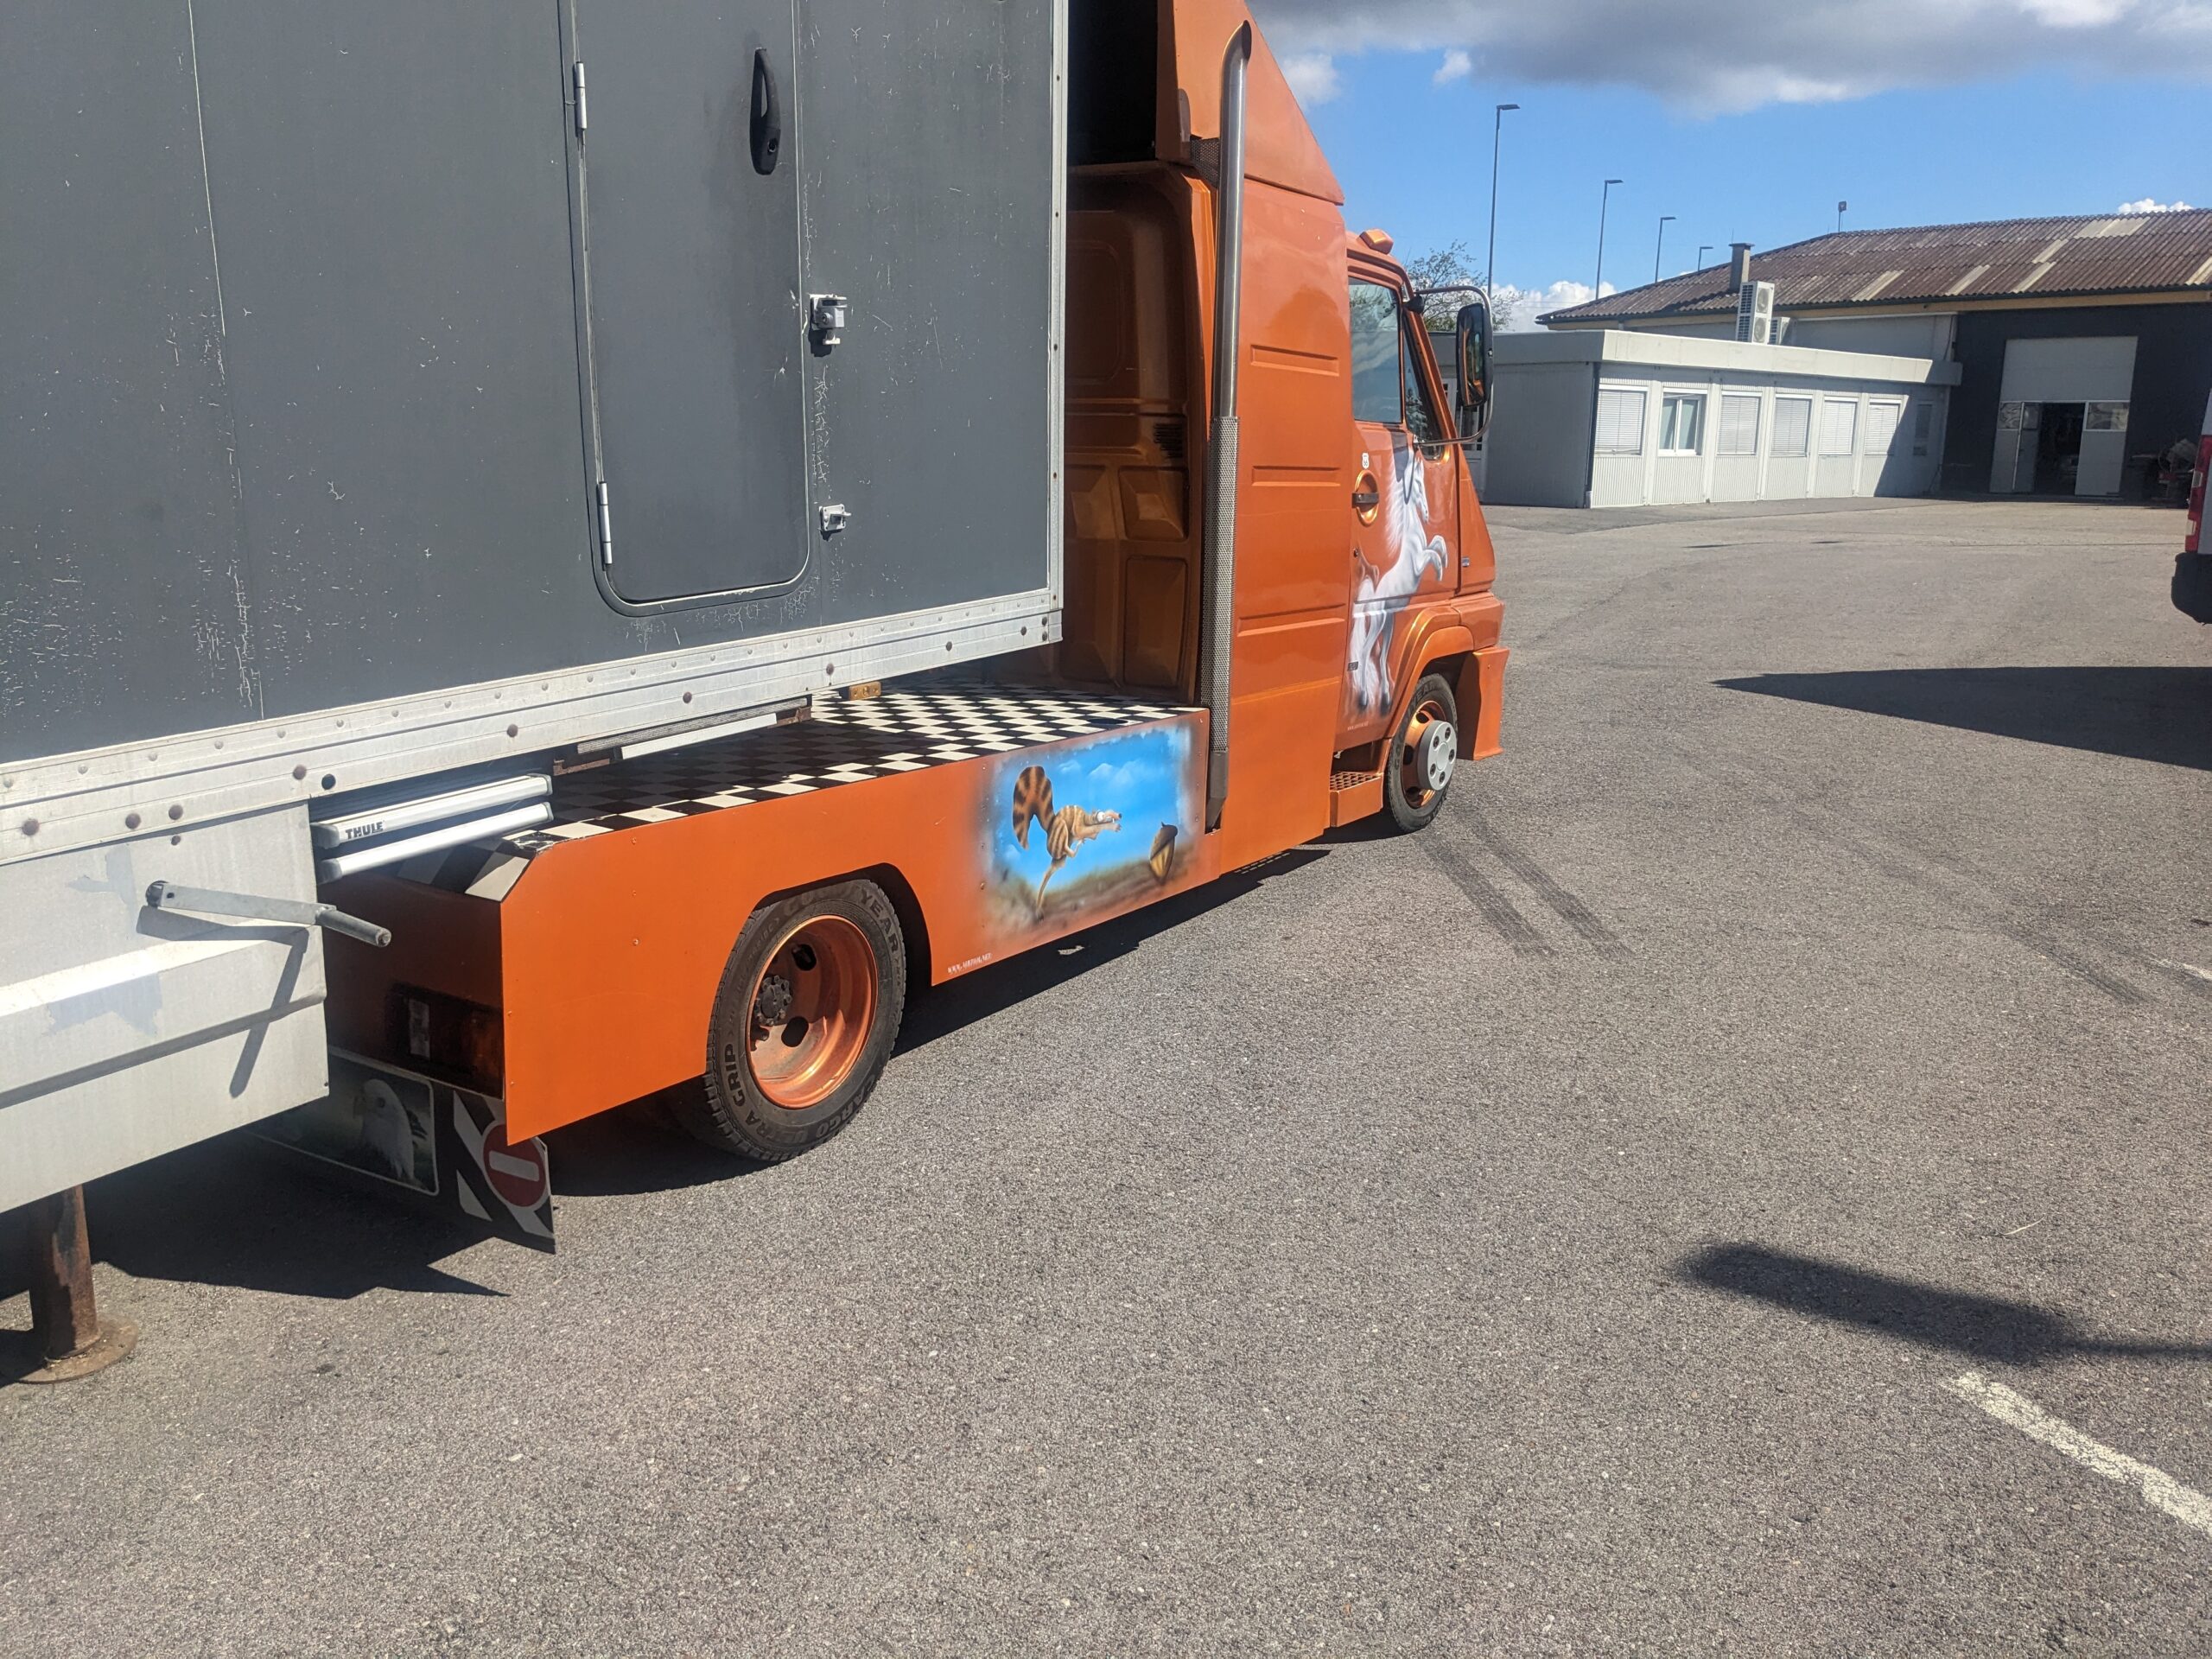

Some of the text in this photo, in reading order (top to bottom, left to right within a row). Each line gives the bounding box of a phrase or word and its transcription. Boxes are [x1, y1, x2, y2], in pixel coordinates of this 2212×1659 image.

[346, 821, 384, 840] THULE
[724, 1043, 746, 1107] GRIP
[816, 1073, 875, 1139] CARGO
